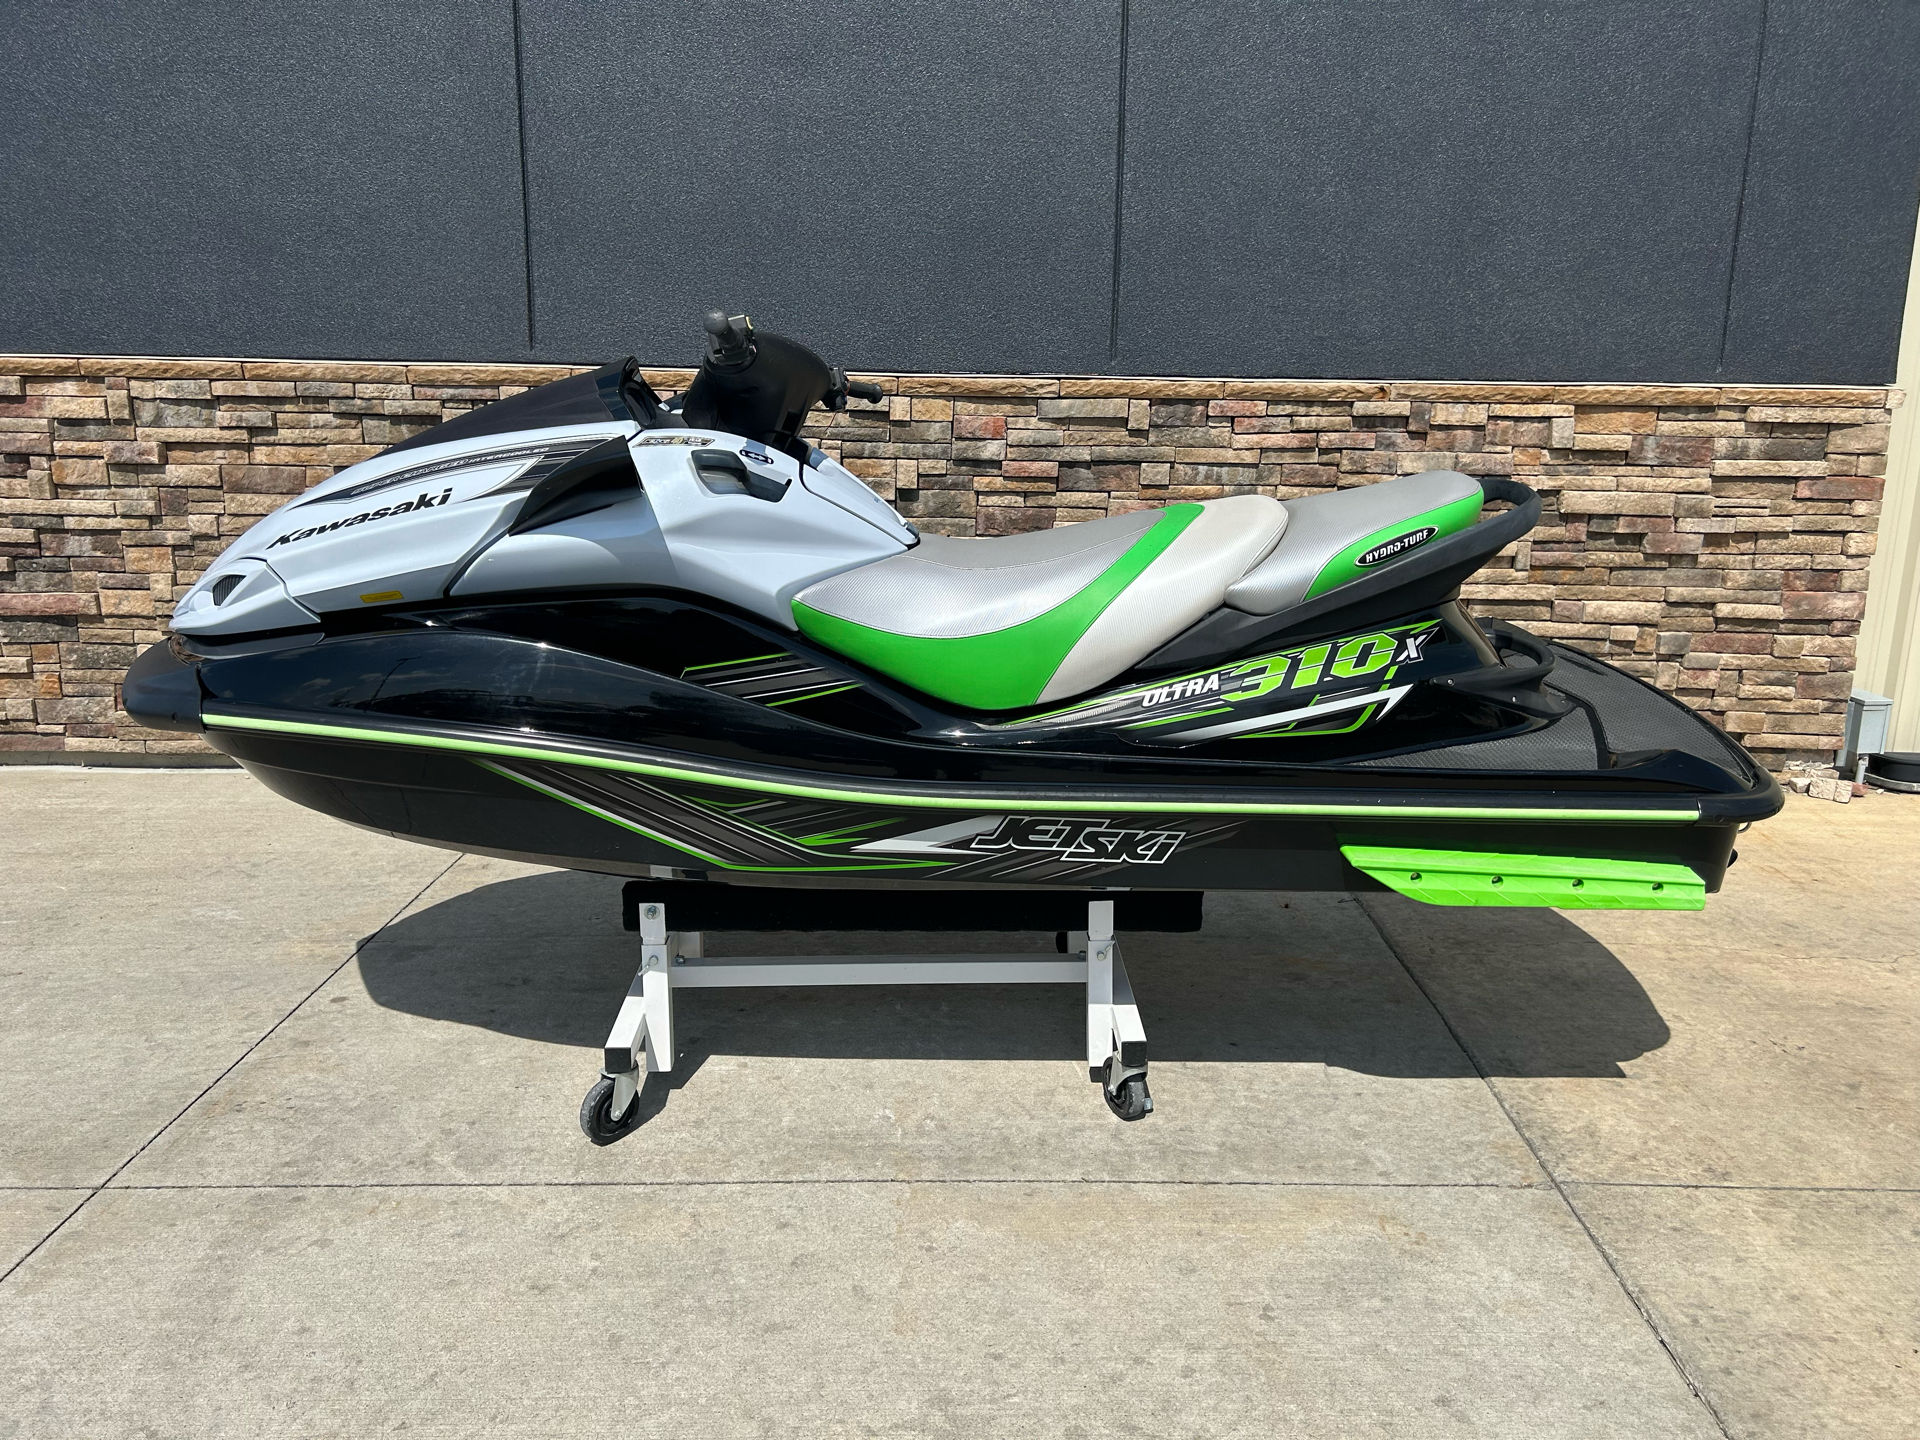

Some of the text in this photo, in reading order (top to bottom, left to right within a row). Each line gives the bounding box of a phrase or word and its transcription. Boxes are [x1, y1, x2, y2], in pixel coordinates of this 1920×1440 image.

[264, 486, 454, 551] Kawasaki
[1365, 529, 1429, 563] HYDRO-TURF
[1141, 673, 1220, 708] ULTRA
